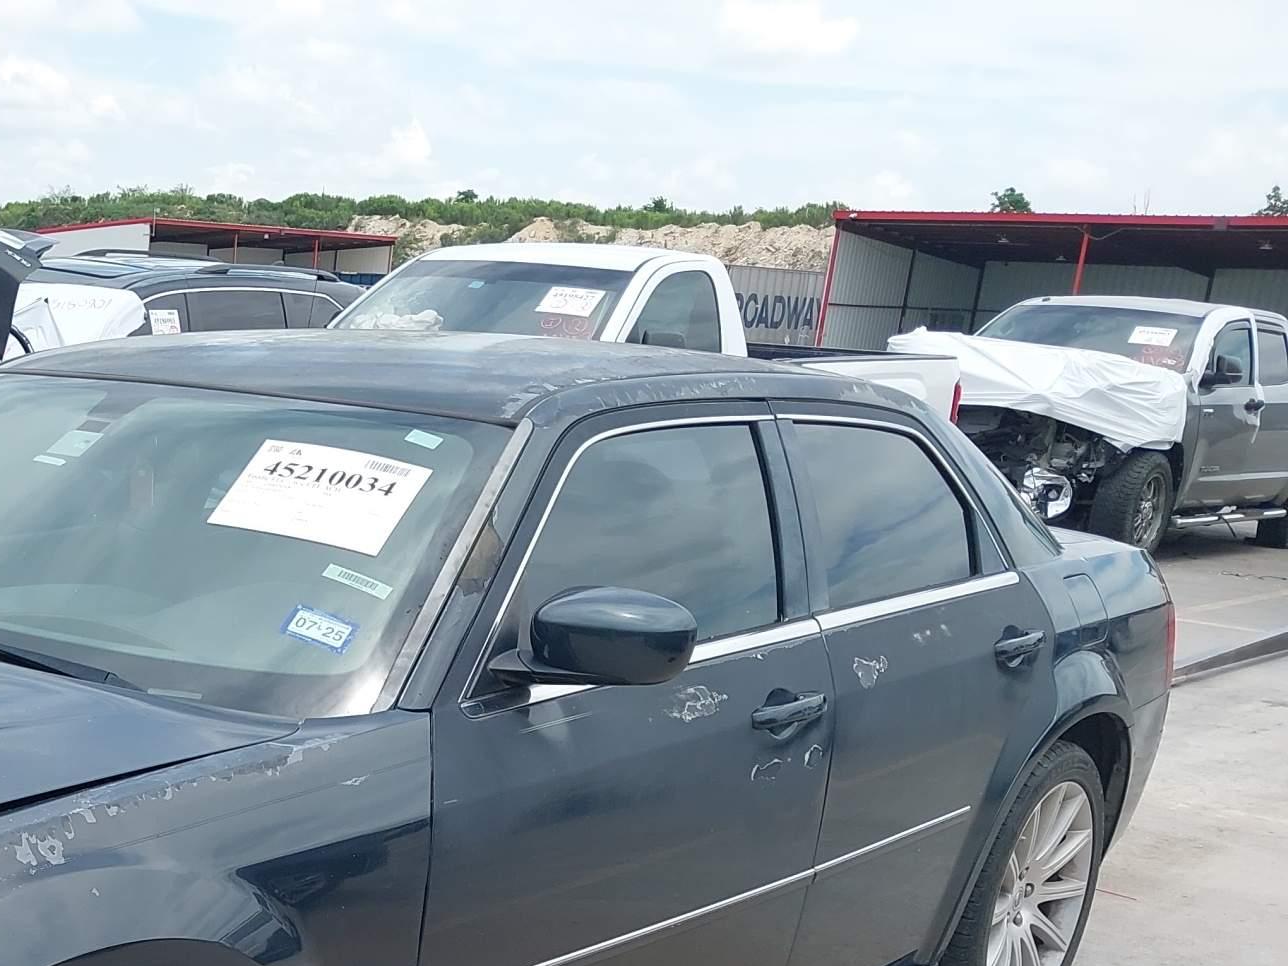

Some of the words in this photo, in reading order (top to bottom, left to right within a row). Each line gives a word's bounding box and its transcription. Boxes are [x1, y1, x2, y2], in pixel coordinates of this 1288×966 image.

[264, 461, 397, 496] 45210034
[295, 616, 318, 631] 07
[321, 626, 346, 642] 25
